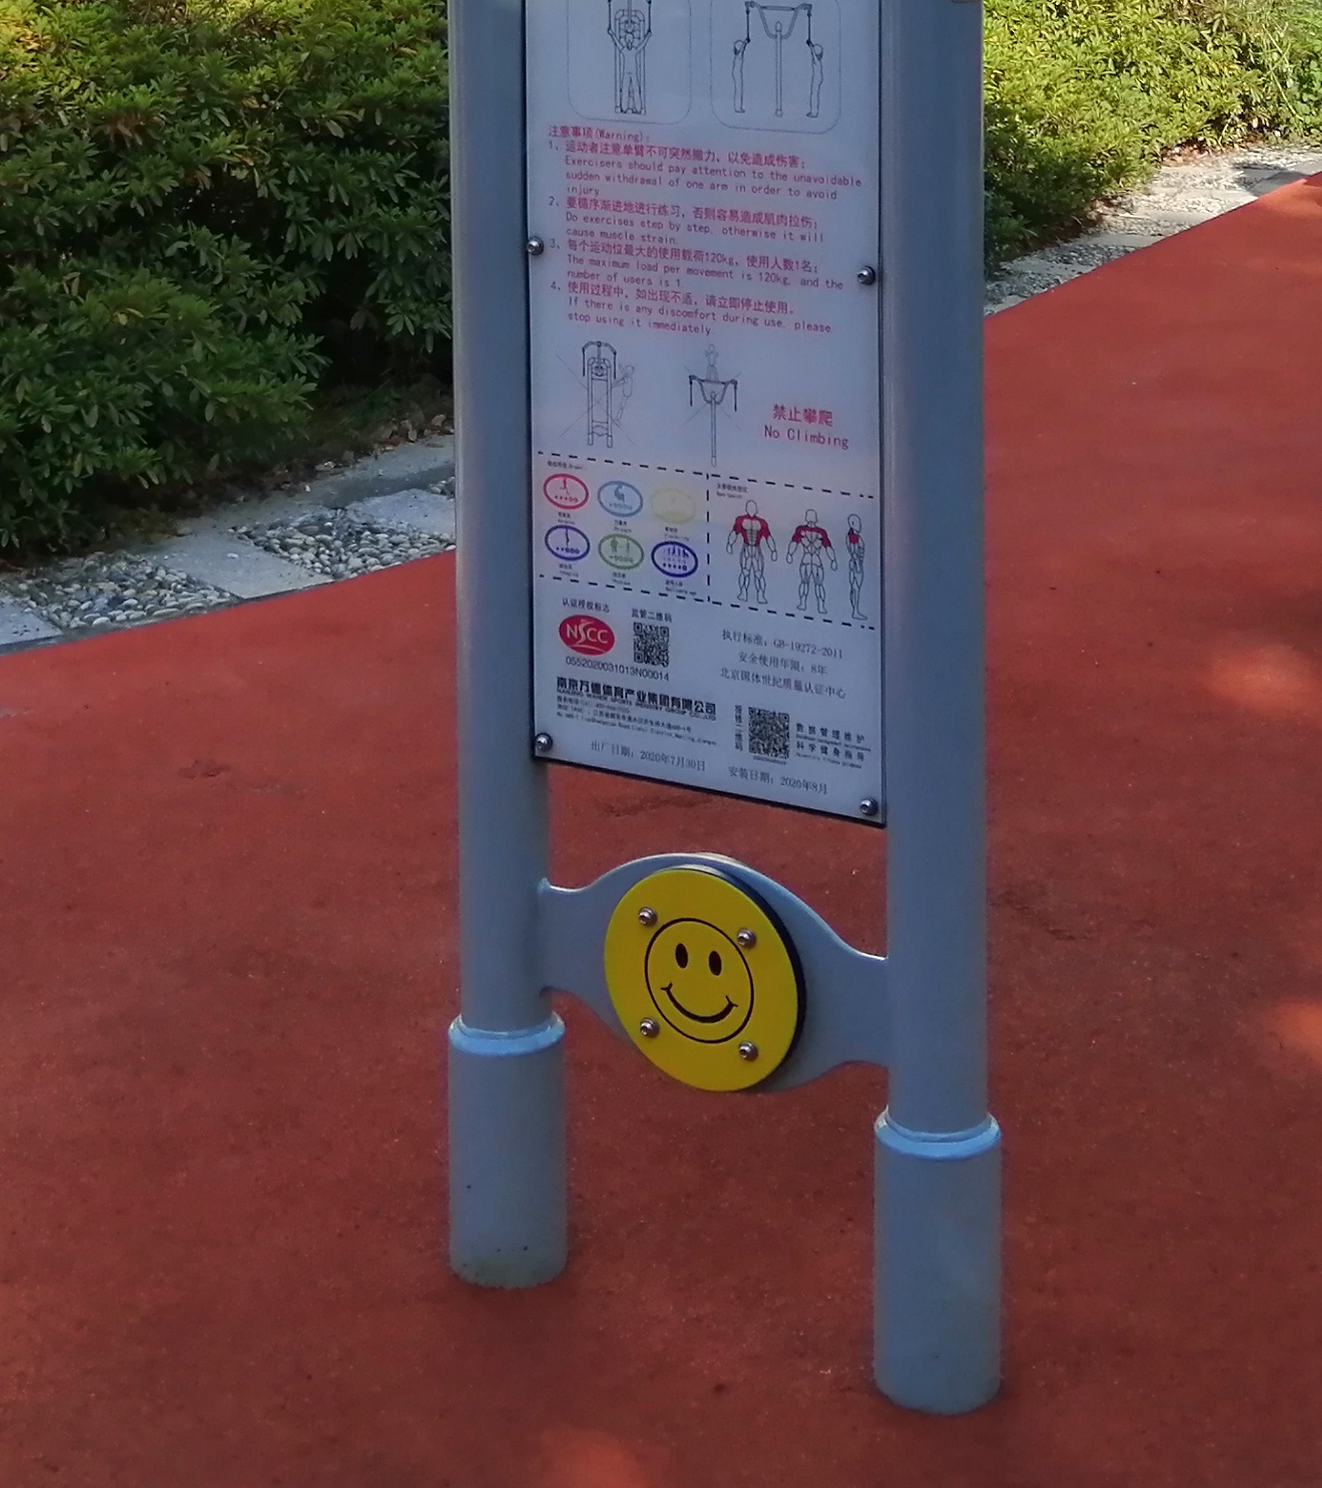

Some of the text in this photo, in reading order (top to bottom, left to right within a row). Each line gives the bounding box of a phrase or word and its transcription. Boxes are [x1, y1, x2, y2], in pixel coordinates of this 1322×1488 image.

[565, 155, 862, 187] Exercisers should pay attention to the unavoidable
[566, 171, 838, 201] sudden withdrawal of one arm in order to avoid
[565, 212, 578, 222] Do
[583, 214, 635, 227] exercises
[640, 219, 664, 230] step
[669, 220, 681, 232] by
[721, 226, 776, 240] otherwise
[783, 230, 794, 241] it
[800, 232, 824, 243] will
[566, 229, 595, 238] cause
[600, 230, 635, 241] muscle
[567, 254, 584, 265] The
[589, 257, 630, 269] maximum
[636, 261, 658, 272] load
[663, 265, 680, 275] per
[686, 267, 734, 279] movement
[741, 270, 752, 281] is
[800, 276, 819, 288] and
[826, 279, 844, 290] the
[567, 270, 600, 281] number
[606, 272, 618, 282] of
[623, 276, 653, 286] users
[659, 277, 670, 287] is
[567, 312, 591, 324] stop
[596, 315, 625, 327] using
[632, 318, 642, 327] it
[568, 296, 578, 307] If
[584, 298, 613, 310] there
[620, 302, 630, 312] is
[636, 305, 653, 315] any
[658, 305, 716, 321] discomfort
[722, 313, 759, 327] during
[794, 321, 832, 333] please
[772, 404, 833, 427] 禁止攀爬
[764, 424, 849, 450] No Climbing
[566, 620, 608, 644] NSCC
